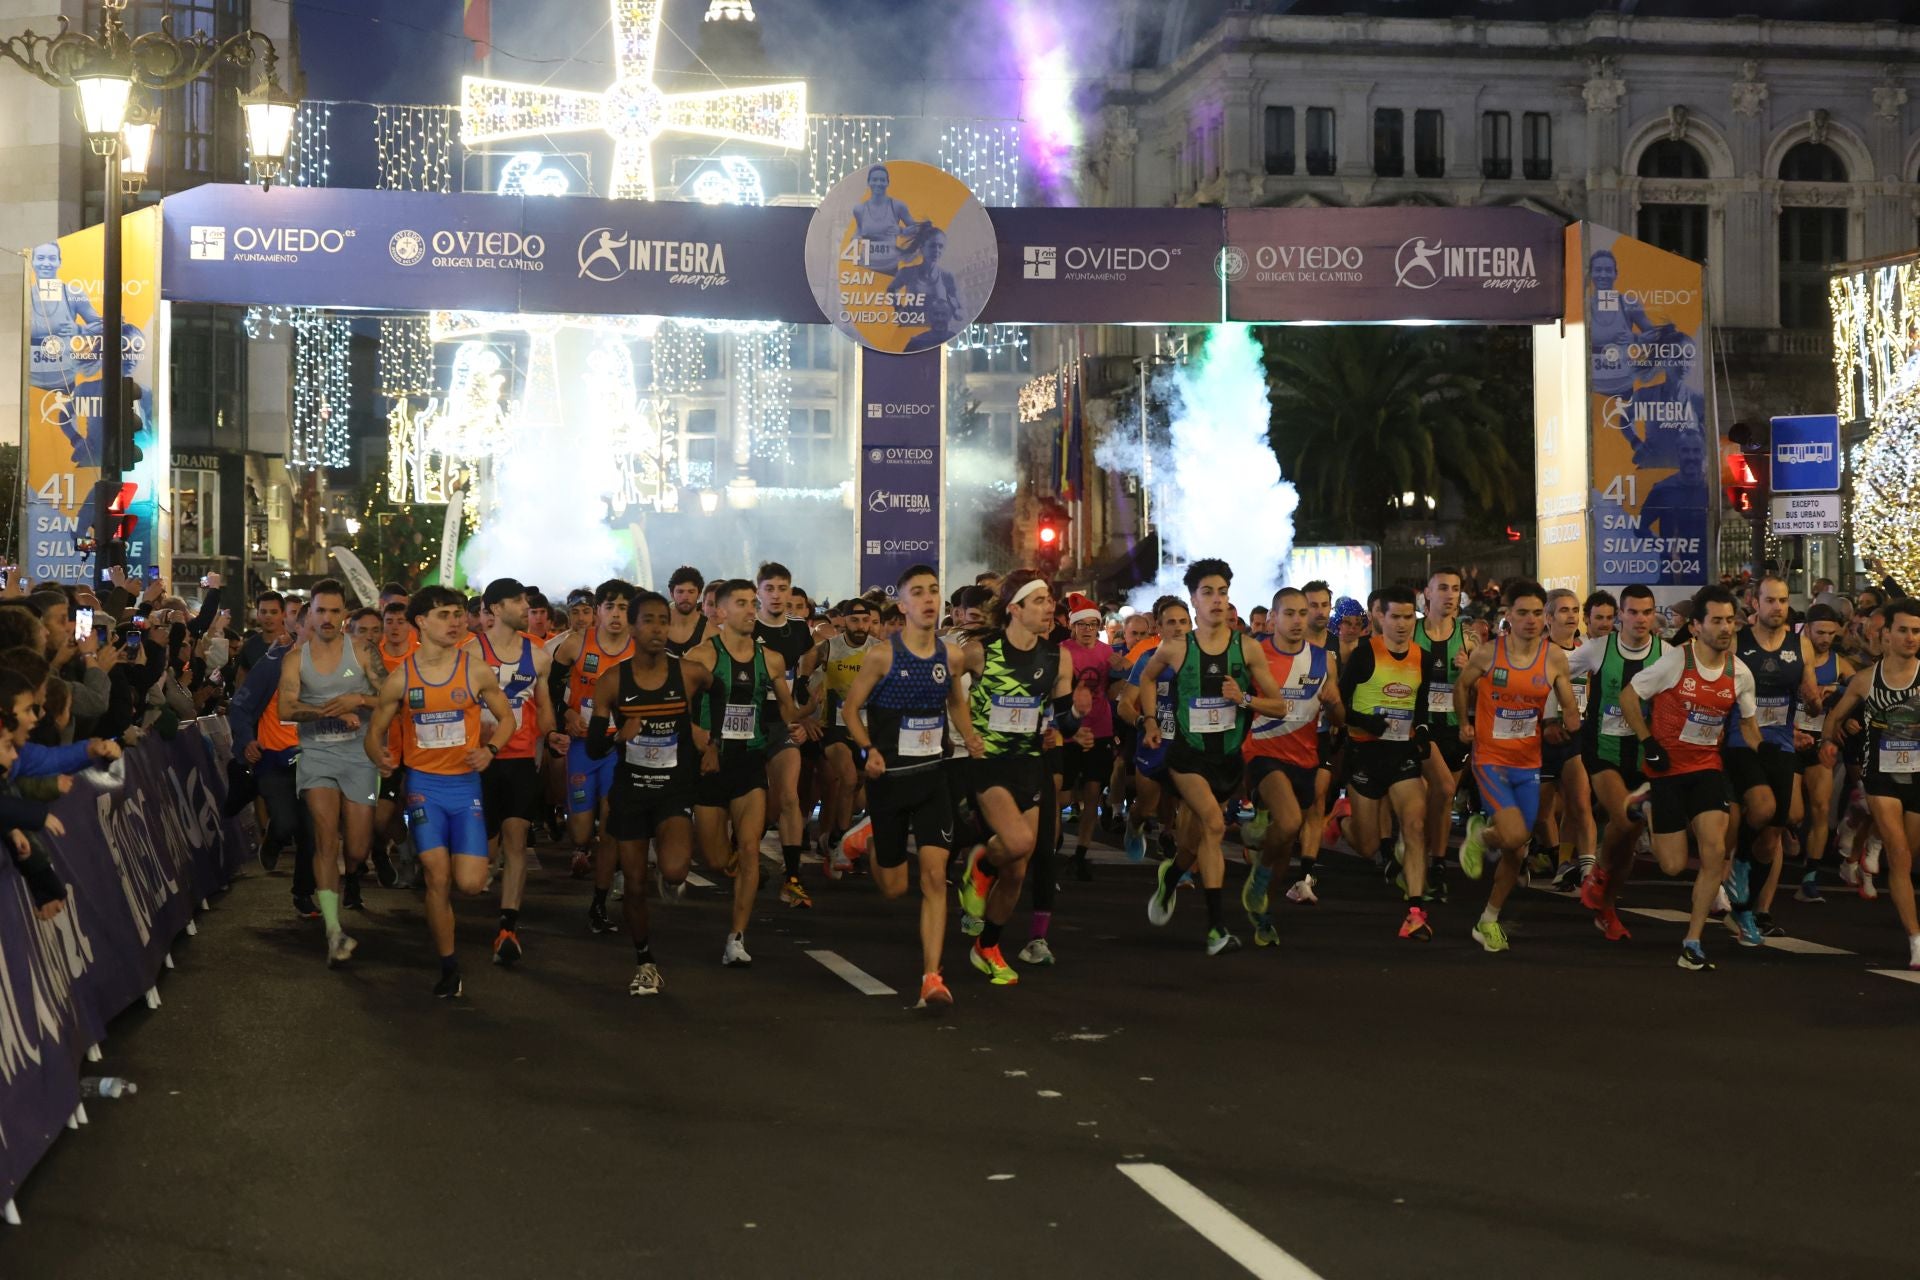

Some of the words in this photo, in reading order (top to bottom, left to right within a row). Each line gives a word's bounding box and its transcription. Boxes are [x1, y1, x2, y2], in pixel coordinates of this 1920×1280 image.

[432, 230, 545, 258] OVIEDO
[233, 254, 298, 263] AYUNTAMIENTO
[629, 240, 726, 274] INTEGRA
[840, 238, 870, 266] 41
[1256, 246, 1364, 270] OVIEDO
[432, 257, 473, 268] ORIGEN
[476, 258, 496, 269] DEL
[498, 259, 544, 271] CAMINO
[1444, 247, 1536, 277] INTEGRA
[840, 271, 875, 285] SAN
[1064, 272, 1126, 281] AYUNTAMIENTO
[1256, 272, 1295, 282] ORIGEN
[1298, 272, 1317, 282] DEL
[1319, 272, 1363, 282] CAMINO
[840, 292, 926, 306] SILVESTRE
[840, 310, 888, 323] OVIEDO
[891, 312, 926, 324] 2024
[1627, 344, 1696, 359] OVIEDO
[1634, 402, 1694, 422] INTEGRA
[886, 448, 933, 460] OVIEDO
[36, 473, 74, 510] 41
[1602, 475, 1636, 506] 41
[890, 494, 930, 508] INTEGRA
[1792, 500, 1820, 508] EXCEPTO
[1800, 510, 1826, 518] URBANO
[36, 516, 80, 533] SAN
[1602, 514, 1642, 530] SAN
[1823, 520, 1838, 528] BICIS
[1602, 538, 1700, 553] SILVESTRE
[1602, 560, 1658, 573] OVIEDO
[1662, 560, 1700, 574] 2024
[1010, 708, 1021, 723] 21
[1208, 709, 1219, 722] 13
[435, 724, 444, 738] 17
[649, 721, 676, 729] VICKY
[724, 717, 749, 731] 4816
[1510, 720, 1524, 732] 29
[1700, 726, 1712, 737] 50
[1896, 752, 1909, 764] 26
